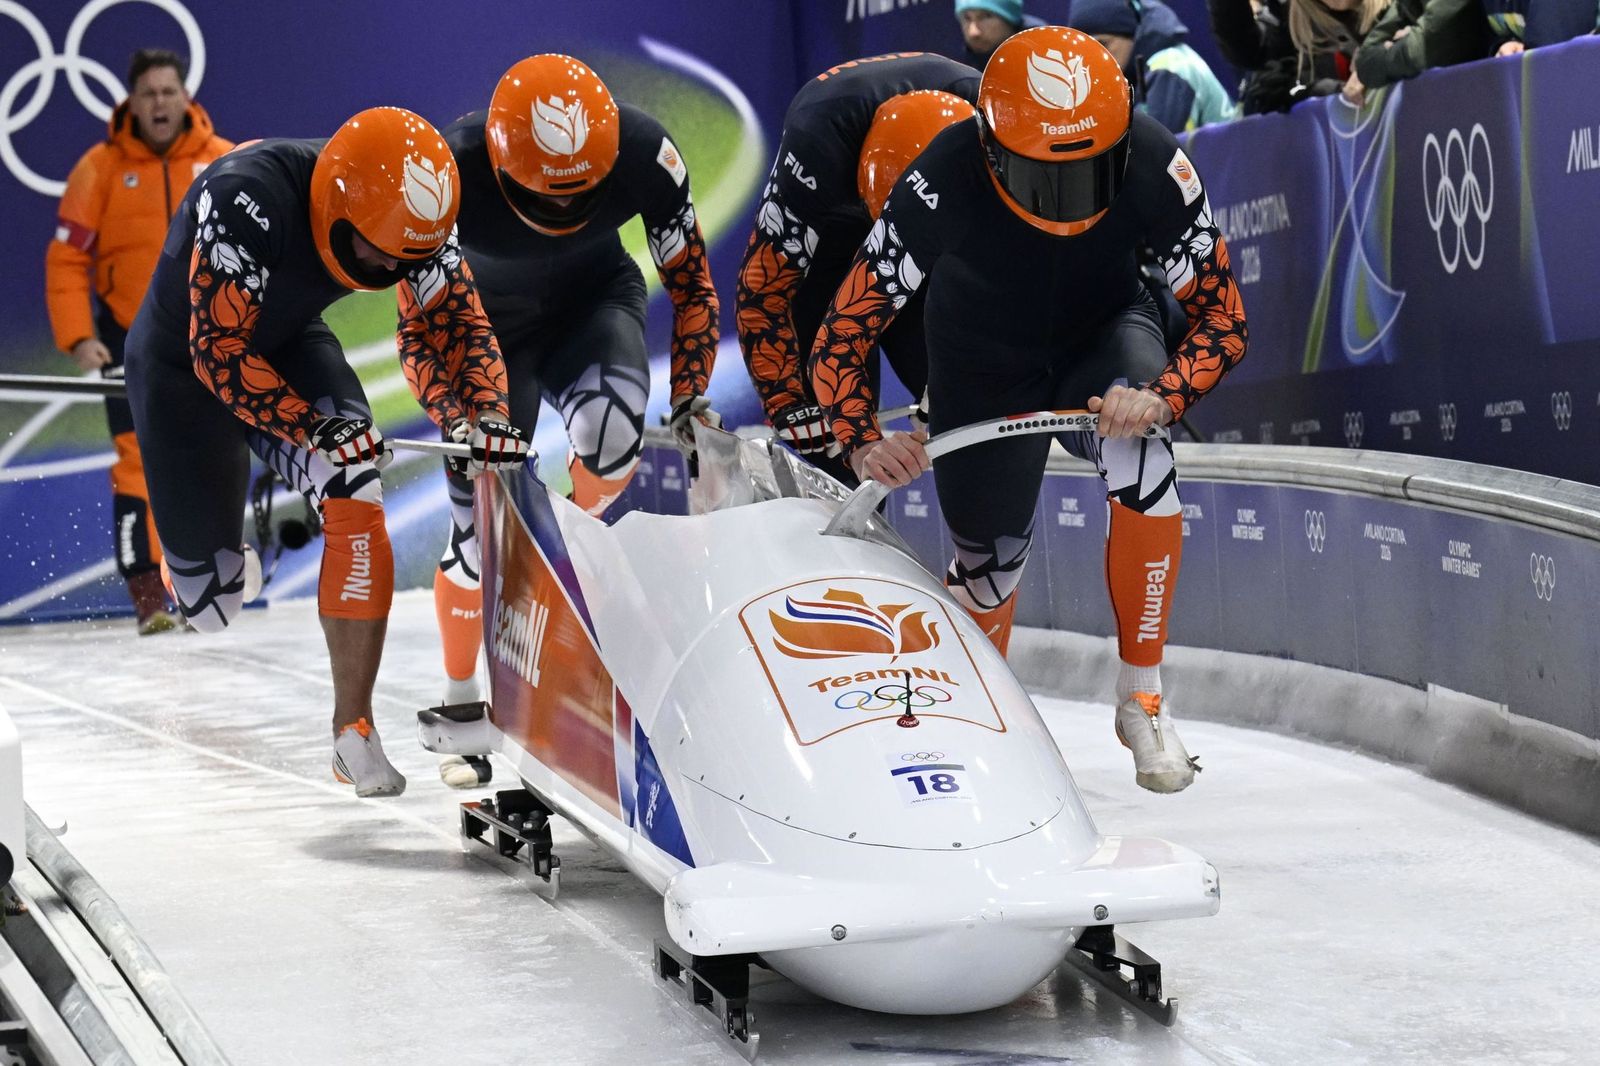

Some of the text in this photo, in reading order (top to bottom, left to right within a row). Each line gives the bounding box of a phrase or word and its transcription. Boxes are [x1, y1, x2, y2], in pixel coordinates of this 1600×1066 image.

[1040, 115, 1098, 135] TeamNL
[1566, 125, 1600, 174] MIL
[541, 160, 592, 177] TeamNL
[784, 151, 817, 190] FILA
[906, 170, 939, 210] FILA
[234, 191, 270, 231] FILA
[786, 406, 820, 424] SEIZ
[334, 420, 366, 443] SEIZ
[488, 422, 522, 438] SEIZ
[1364, 522, 1407, 545] MILANO CORTINA
[1449, 539, 1471, 559] OLYMPIC
[340, 531, 372, 602] TeamNL
[1441, 555, 1461, 575] WINTER
[1136, 554, 1170, 643] TeamNL
[489, 573, 549, 688] TeamNL
[808, 666, 960, 693] TeamNL
[907, 773, 960, 795] 18
